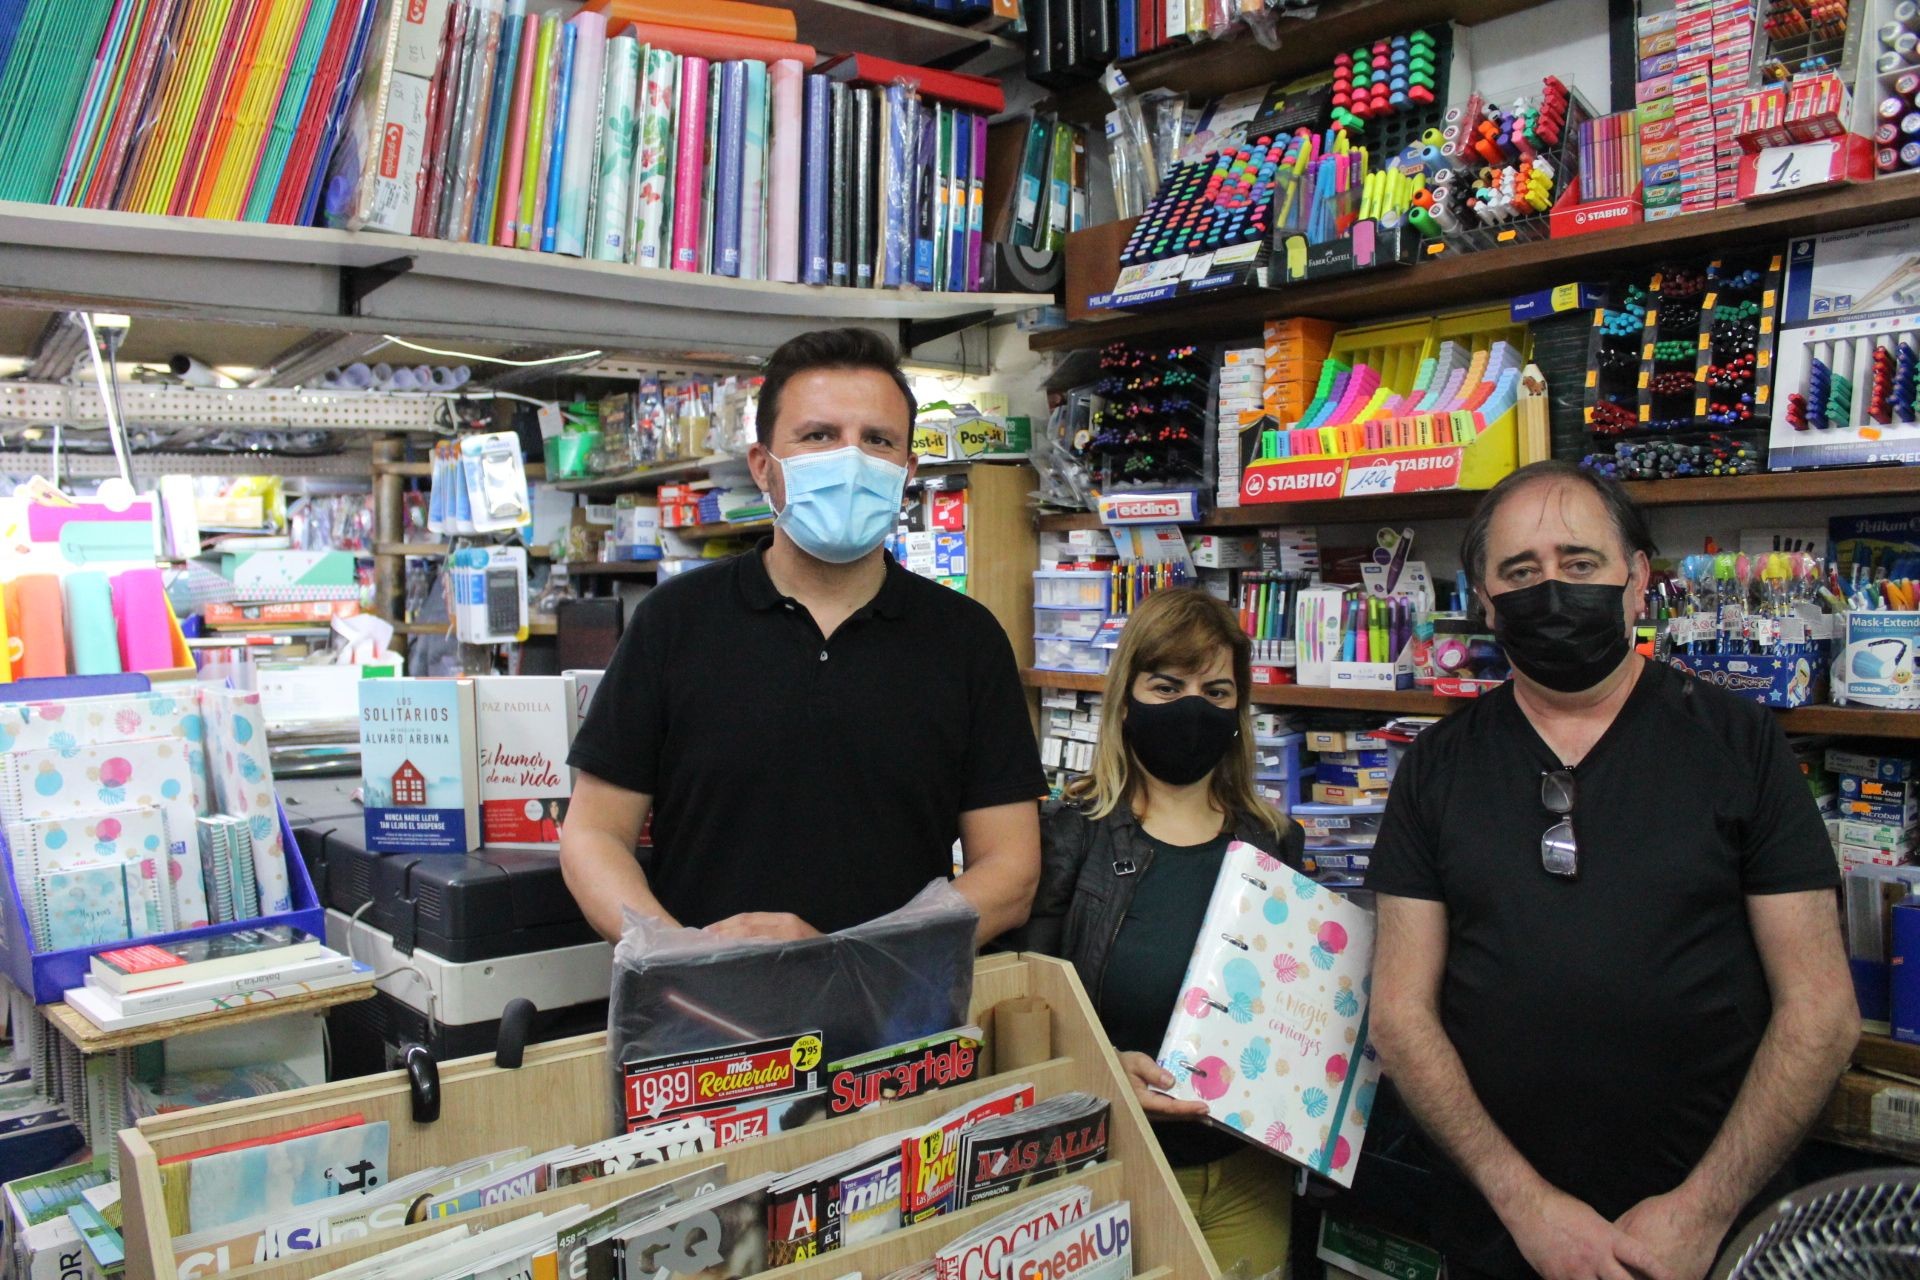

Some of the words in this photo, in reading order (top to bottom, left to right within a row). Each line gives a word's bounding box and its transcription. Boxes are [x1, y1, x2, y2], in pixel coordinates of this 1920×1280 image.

[1587, 206, 1629, 221] STABILO
[1866, 223, 1911, 238] permanent
[1198, 274, 1231, 287] STAEDTLER
[1123, 289, 1165, 303] STAEDTLER
[911, 435, 944, 449] ost-it
[1392, 455, 1454, 473] STABILO
[1267, 471, 1337, 492] STABILO
[1119, 502, 1178, 517] edding
[1856, 518, 1908, 534] Pelikan
[264, 603, 301, 613] PUZZLE
[397, 697, 412, 706] LOS
[481, 702, 501, 712] PAZ
[504, 702, 551, 713] PADILLA
[364, 707, 449, 721] SOLITARIOS
[365, 731, 403, 745] ÁLVARO
[409, 733, 449, 744] ARBINA
[494, 742, 546, 768] humor
[486, 768, 499, 784] de
[501, 773, 517, 784] mi
[520, 760, 561, 788] vida
[384, 813, 403, 821] NUNCA
[403, 813, 420, 822] NADIE
[421, 813, 439, 822] LLEVÓ
[1316, 818, 1350, 828] GOMAS
[380, 821, 390, 829] TAN
[390, 821, 407, 830] LEJOS
[408, 822, 416, 830] EL
[416, 821, 445, 830] SUSPENSE
[1317, 857, 1347, 867] GOMAS
[798, 1038, 815, 1048] SOLO
[726, 1057, 753, 1075] más
[698, 1059, 790, 1098] Recuerdos
[631, 1071, 690, 1112] 1989
[720, 1115, 763, 1144] DIEZ
[975, 1139, 1041, 1183] MÁS
[843, 1165, 901, 1215] mia
[559, 1234, 576, 1249] 458
[625, 1209, 726, 1279] GQ
[959, 1198, 1085, 1280] COCINA
[1383, 1258, 1396, 1272] 80
